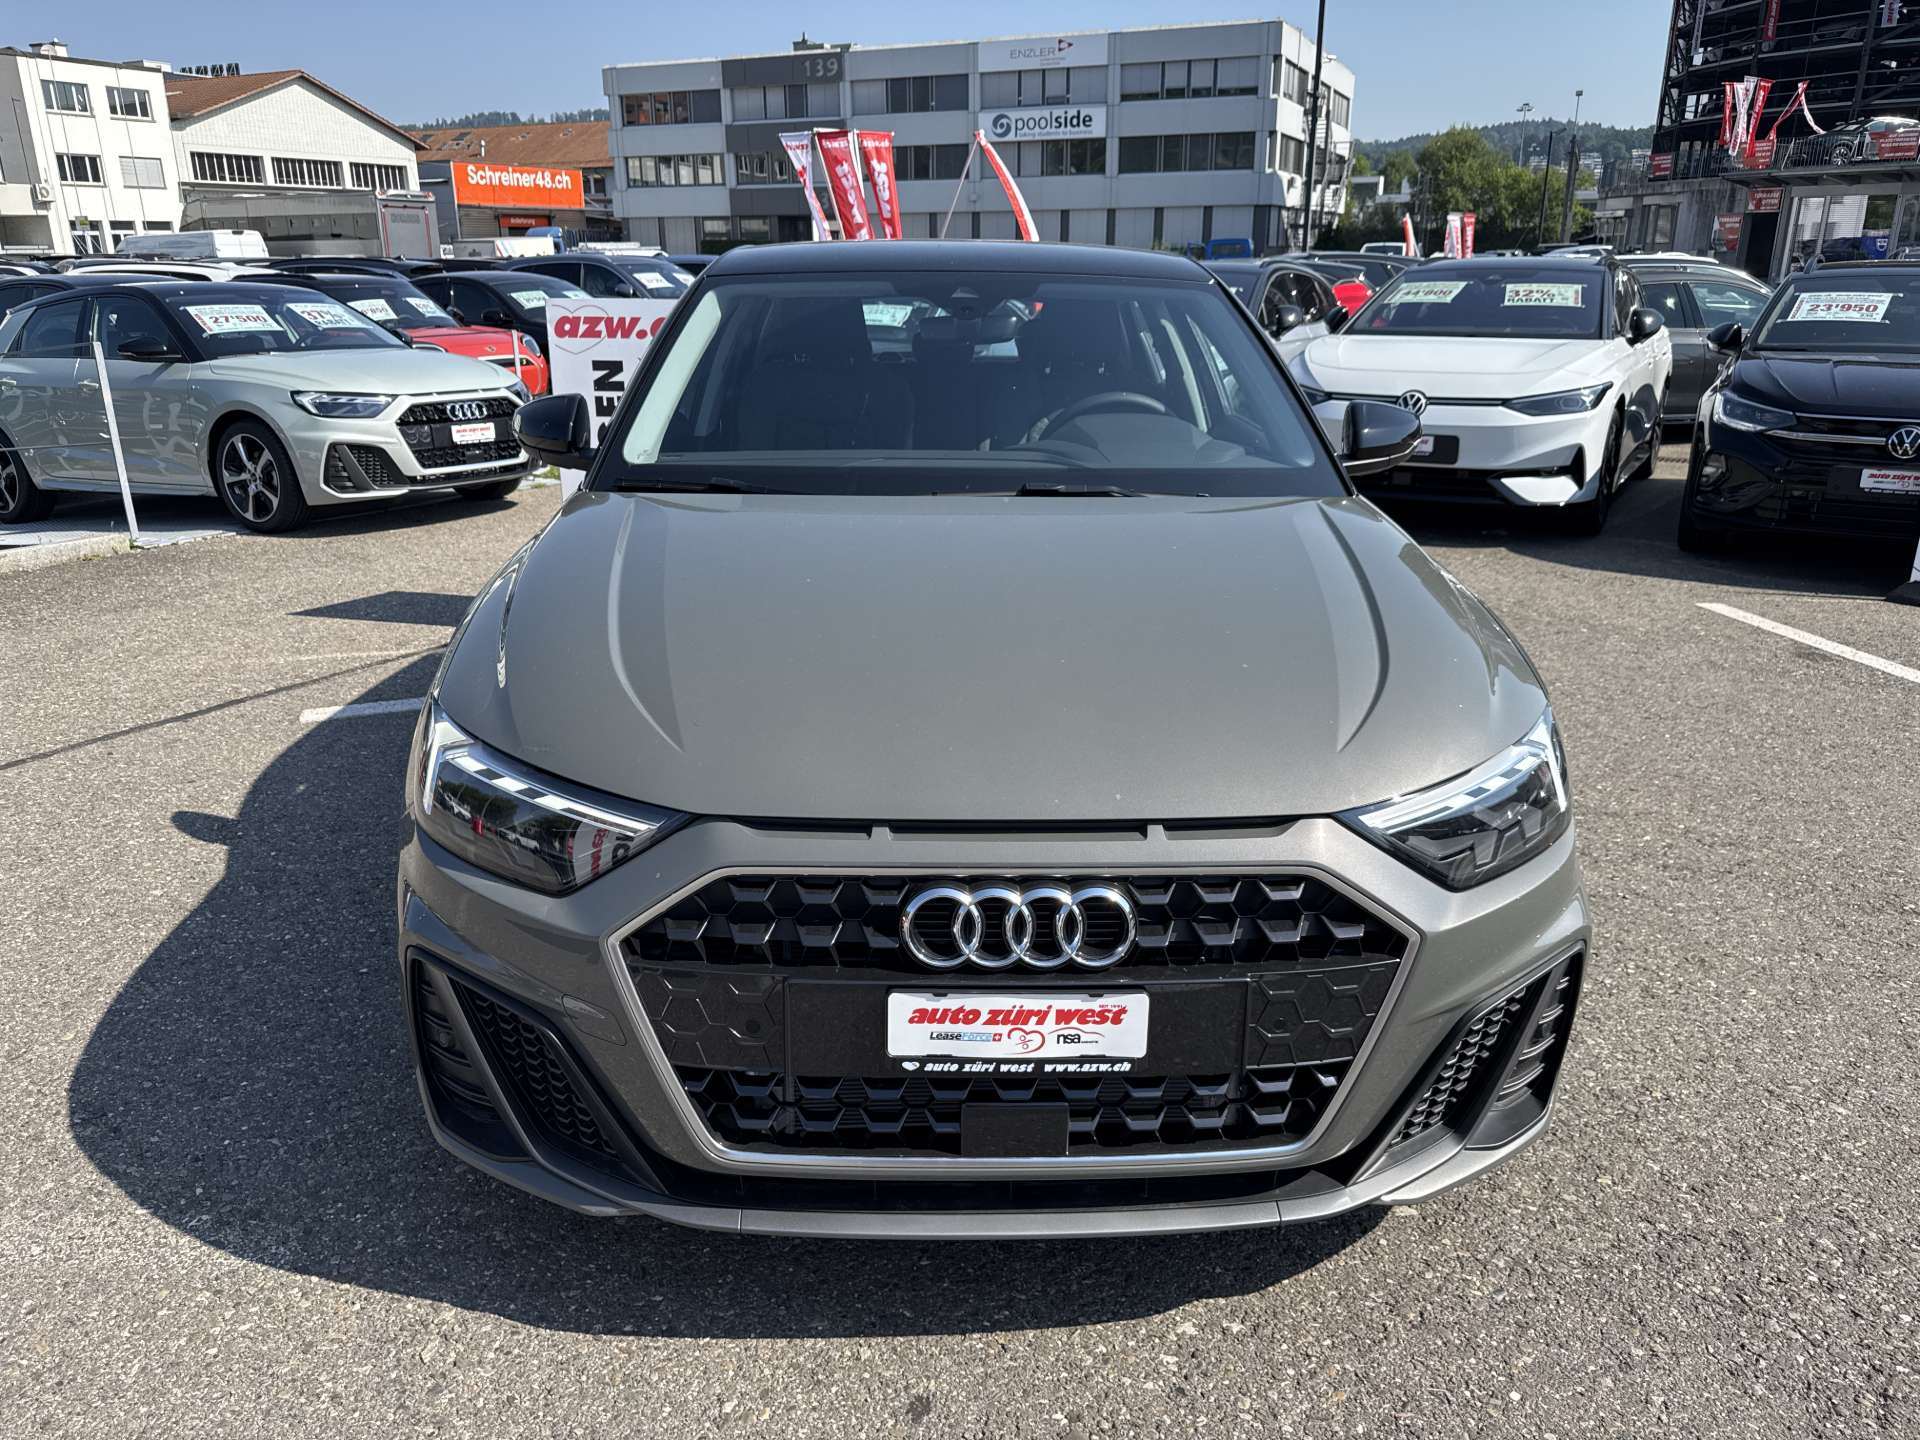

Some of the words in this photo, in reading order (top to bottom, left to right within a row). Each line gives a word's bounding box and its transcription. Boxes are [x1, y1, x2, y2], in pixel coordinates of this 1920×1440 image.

[1009, 47, 1057, 59] ENZLER
[803, 58, 838, 77] 139
[1014, 110, 1093, 138] poolside
[467, 164, 572, 190] Schreiner48.ch
[1507, 289, 1555, 298] 32%
[1808, 303, 1879, 313] 23'950
[208, 315, 268, 324] 27'500
[908, 1005, 981, 1025] auto
[981, 1005, 1053, 1026] züri
[1055, 1007, 1128, 1026] west
[929, 1031, 993, 1042] LeaseForce
[1057, 1033, 1081, 1045] nsa
[924, 1062, 958, 1072] auto
[962, 1062, 996, 1072] züri
[1000, 1062, 1035, 1073] west
[1044, 1062, 1133, 1073] www.azw.ch
